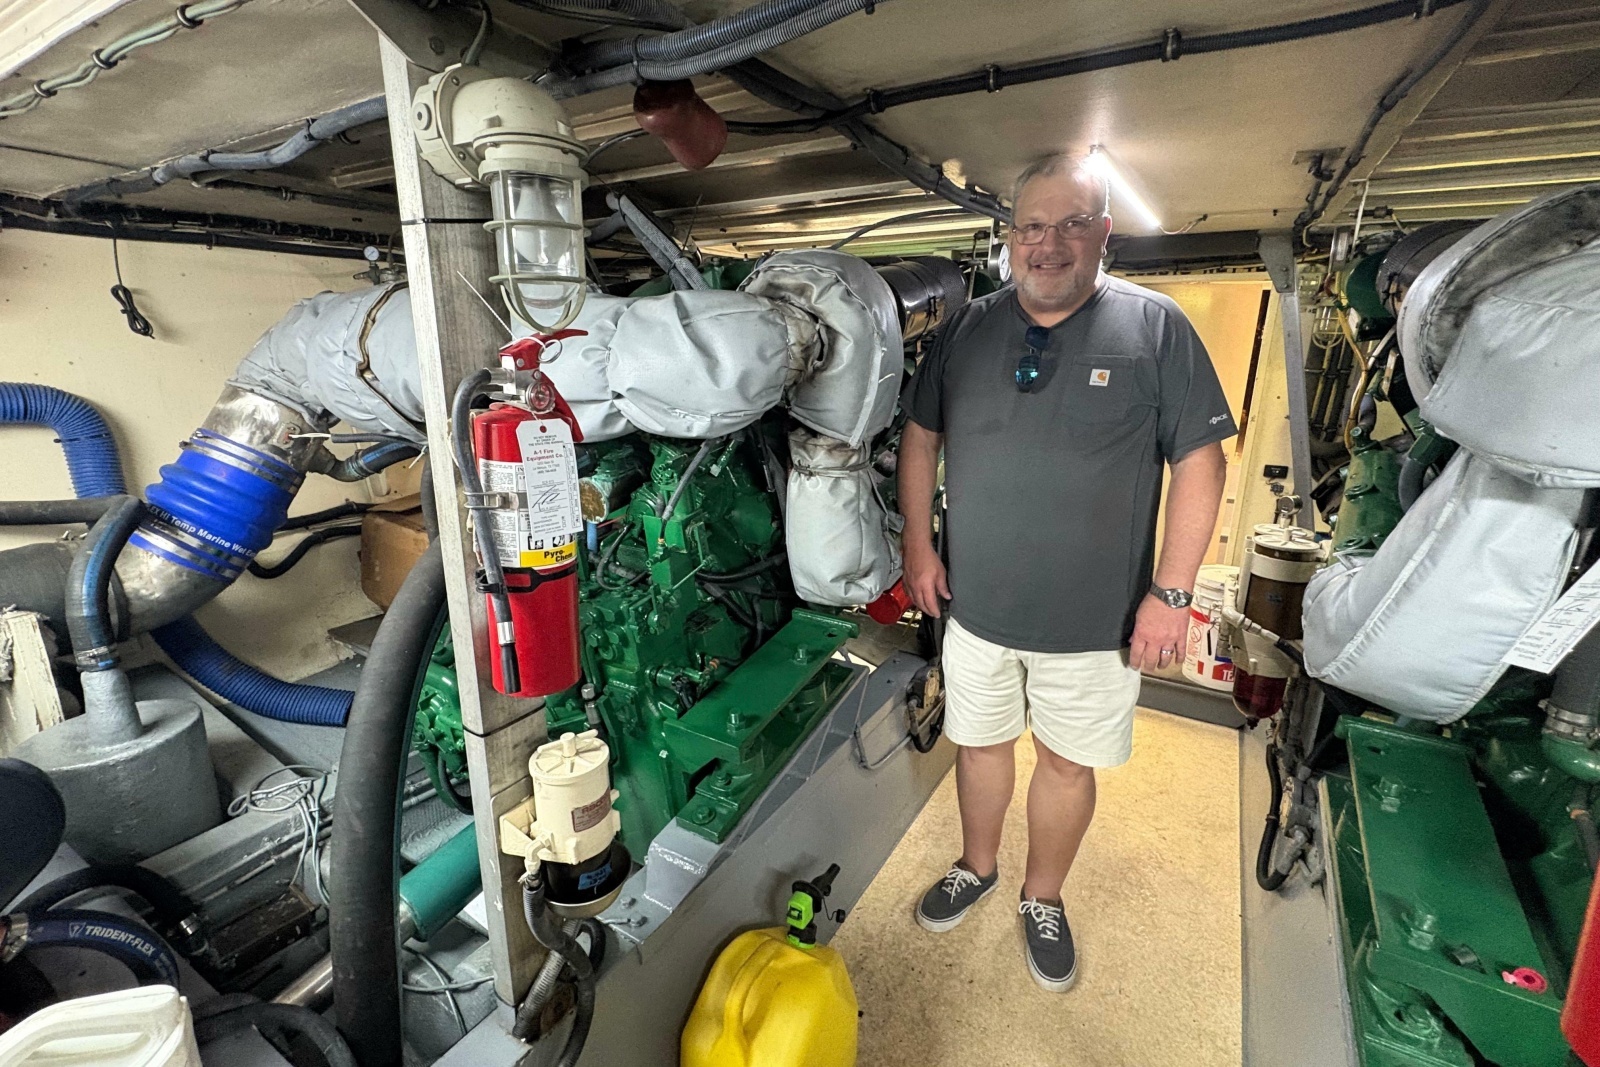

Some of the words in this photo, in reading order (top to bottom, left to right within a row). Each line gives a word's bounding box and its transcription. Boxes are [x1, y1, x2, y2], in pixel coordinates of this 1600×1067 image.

[526, 454, 555, 462] Equipment
[170, 515, 196, 533] Temp
[197, 528, 231, 548] Marine
[555, 552, 573, 562] Chem
[1222, 669, 1234, 681] TE
[85, 925, 156, 957] TRIDENT-FLEX
